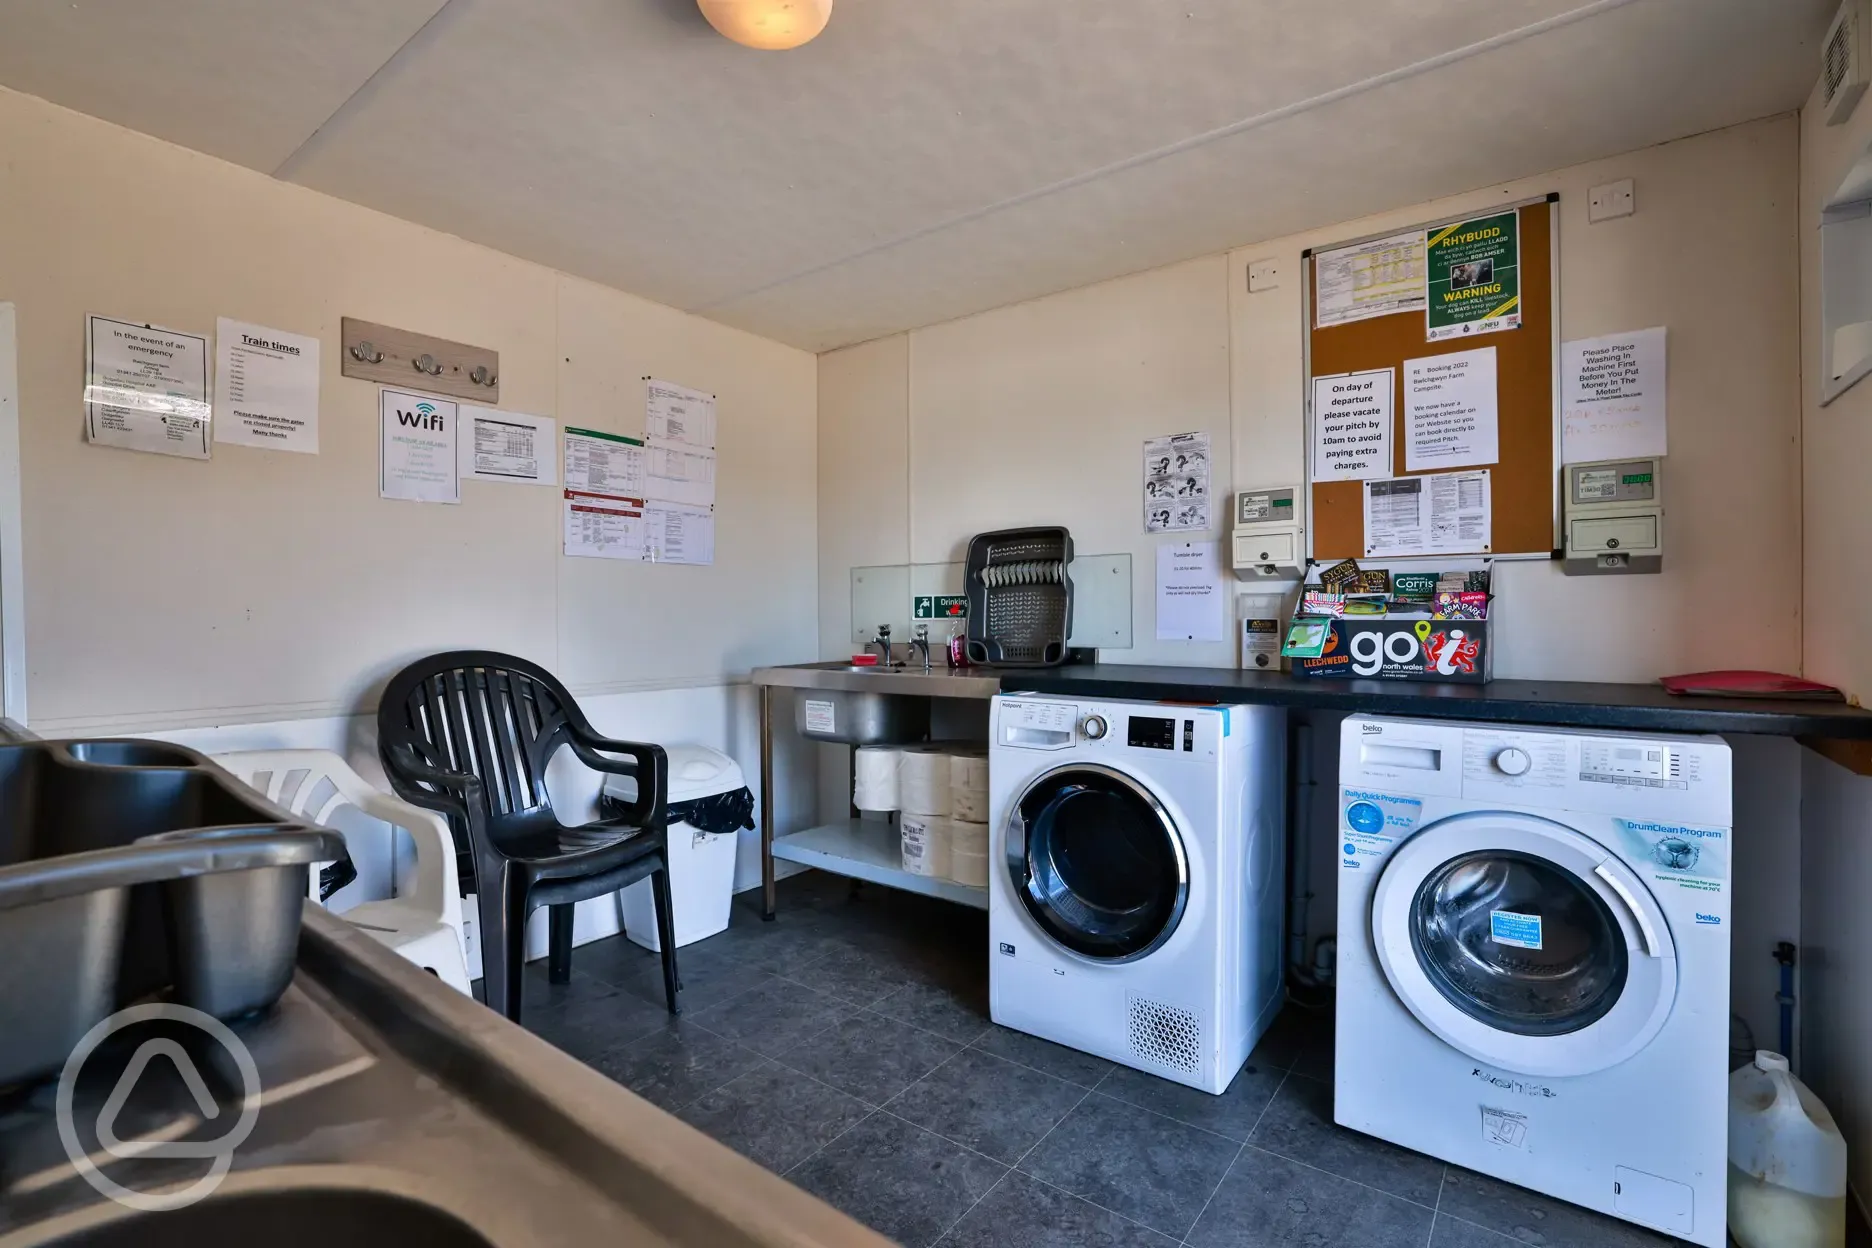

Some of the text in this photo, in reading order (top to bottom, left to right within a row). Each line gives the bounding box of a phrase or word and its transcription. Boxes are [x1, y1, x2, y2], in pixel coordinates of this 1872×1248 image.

[1443, 227, 1500, 247] RHYBUDD
[1488, 236, 1508, 244] LLADD
[1484, 248, 1504, 257] AMSER
[1444, 284, 1501, 302] WARNING
[1448, 306, 1470, 314] ALWAYS
[141, 337, 163, 346] event
[242, 334, 268, 347] Train
[272, 342, 300, 354] times
[128, 346, 173, 358] emergency
[1583, 344, 1634, 356] Please Place
[1586, 355, 1620, 364] Washing
[1582, 364, 1615, 373] Machine
[1414, 375, 1447, 384] Bwlchgwyn
[1582, 381, 1608, 389] Money
[1332, 396, 1373, 405] departure
[1324, 408, 1380, 420] please vacate
[1415, 412, 1438, 420] booking
[397, 410, 443, 431] Wifi
[1325, 425, 1344, 433] your
[1346, 422, 1366, 431] pitch
[1358, 433, 1381, 442] avoid
[1326, 450, 1353, 458] paying
[1334, 462, 1368, 470] charges.
[1324, 561, 1354, 580] SYGUN
[1396, 579, 1433, 588] Corris
[1440, 604, 1481, 617] FARM PARK
[1351, 632, 1419, 675] go
[1304, 656, 1348, 667] LLECHWEDD
[1362, 724, 1382, 732] beko
[1345, 790, 1422, 806] Daily Quick Programme
[1628, 822, 1721, 838] DrumClean Program
[1494, 912, 1521, 920] REGISTER
[1696, 913, 1720, 922] beko
